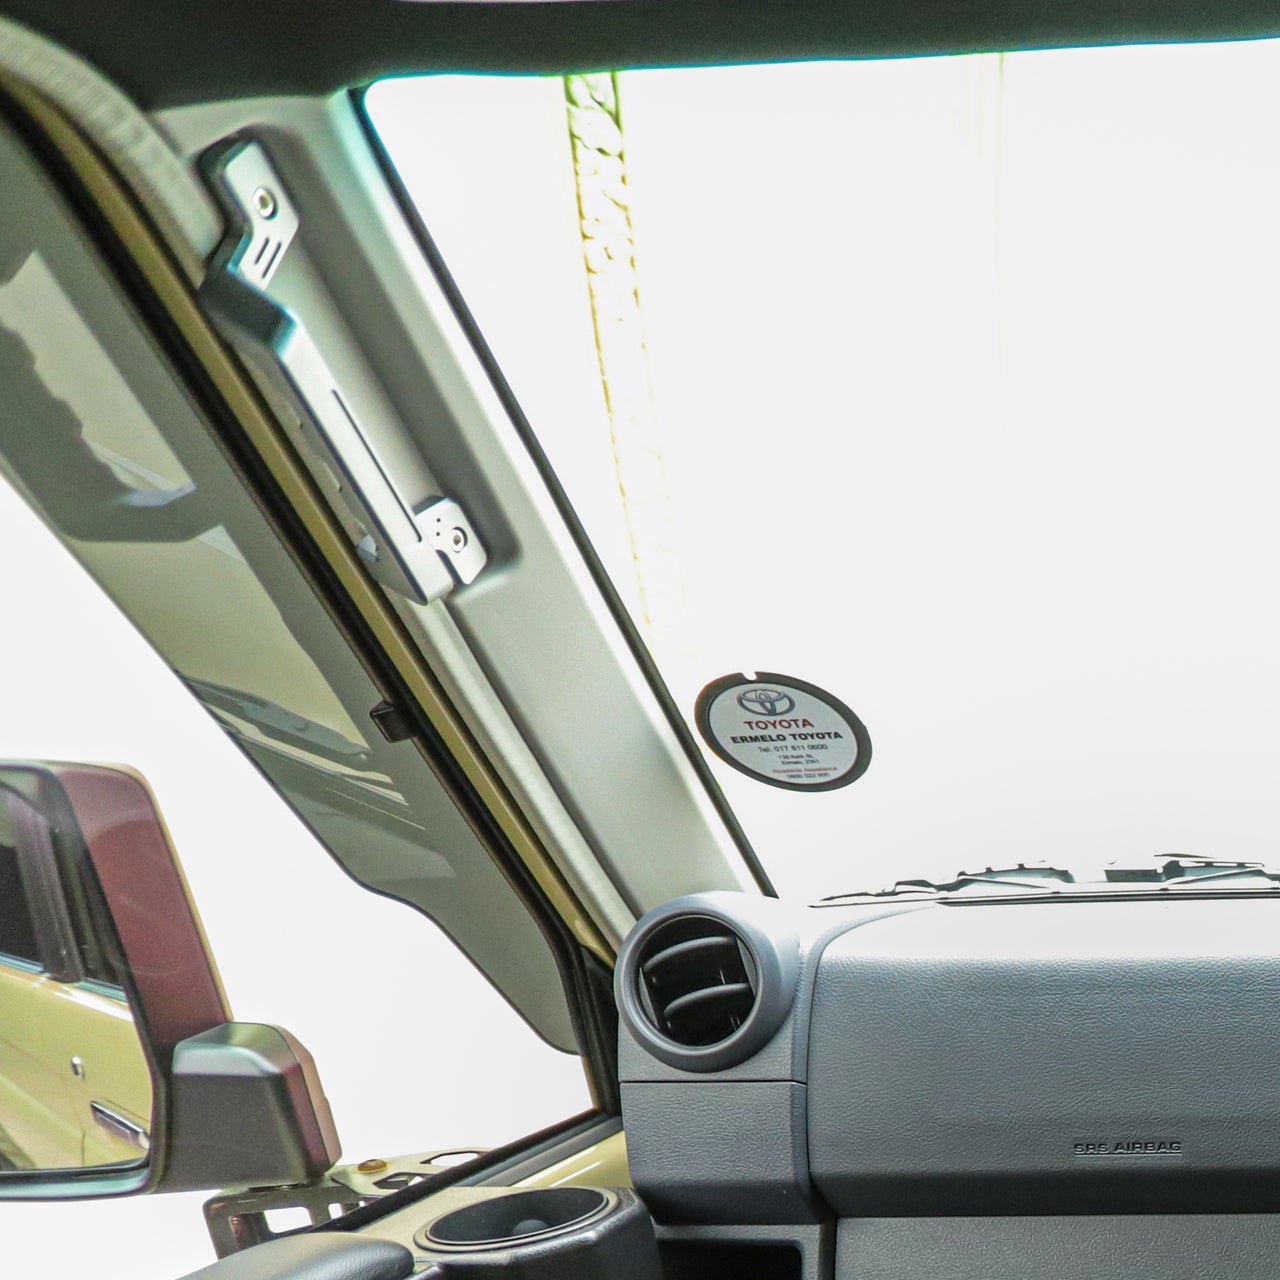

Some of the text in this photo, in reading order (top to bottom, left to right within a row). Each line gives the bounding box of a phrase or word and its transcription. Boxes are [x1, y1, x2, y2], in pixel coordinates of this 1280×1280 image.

[743, 719, 815, 731] TOYOTA
[730, 731, 844, 744] ERMELO TOYOTA
[1074, 1141, 1182, 1154] SRS AIRBAG
